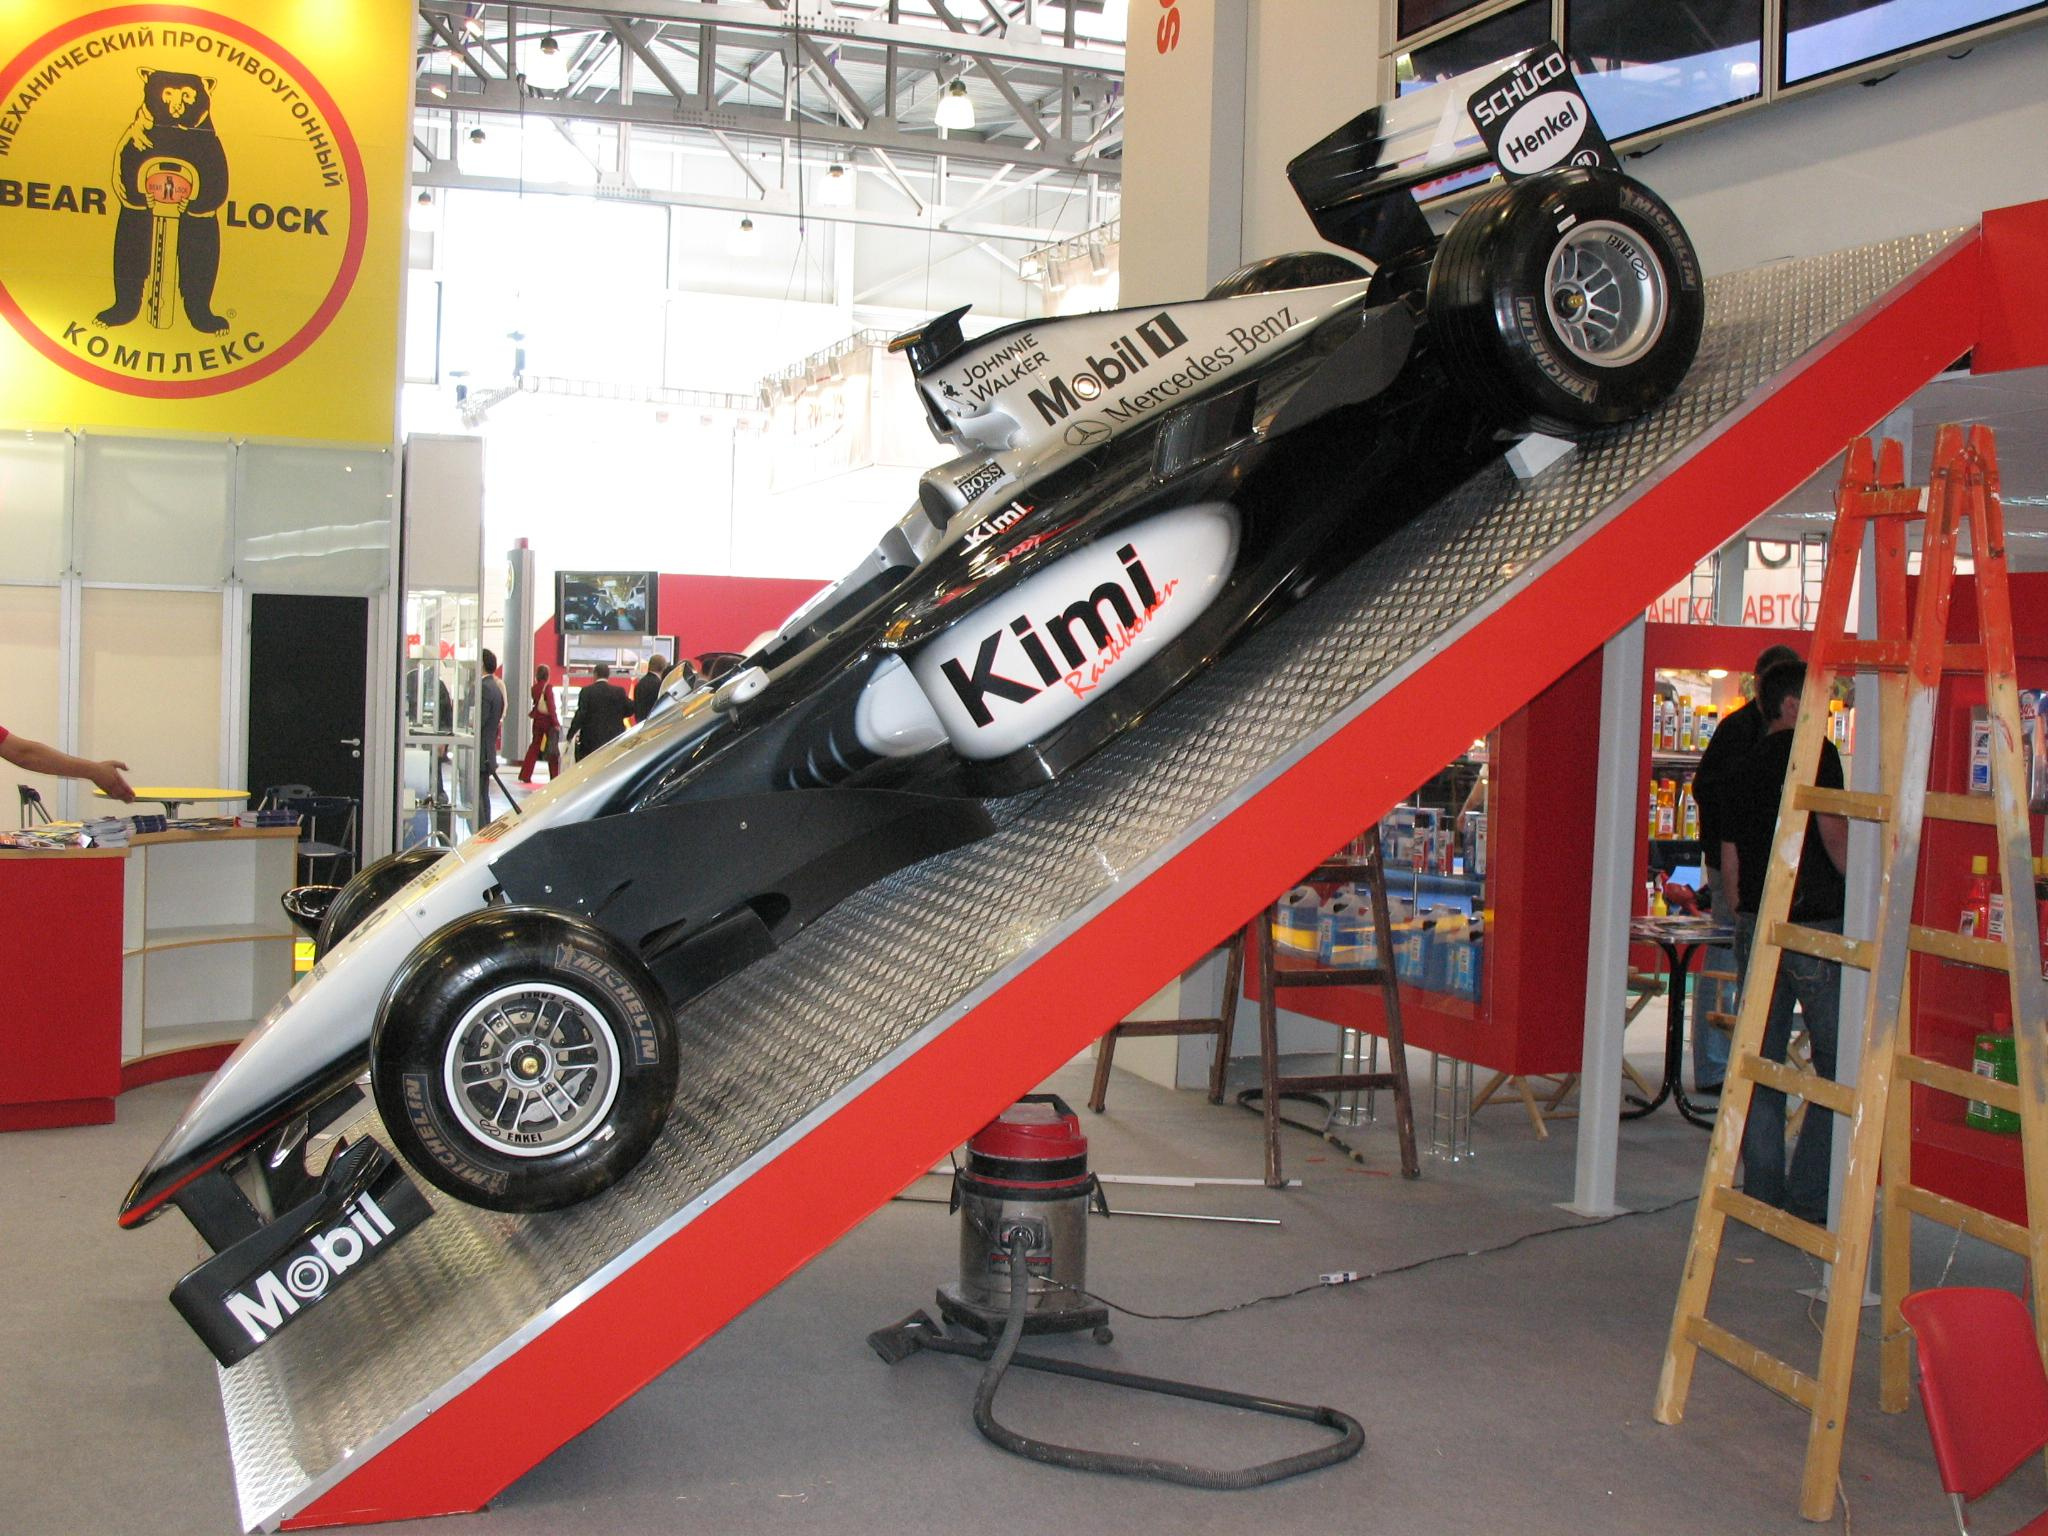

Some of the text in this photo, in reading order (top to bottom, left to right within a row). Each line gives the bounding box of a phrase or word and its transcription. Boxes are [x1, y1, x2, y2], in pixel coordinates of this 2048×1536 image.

[0, 26, 345, 188] МЕХАНИЧЕСКИЙ ПРОТИВОУГОННЫЙ
[1474, 52, 1567, 127] SCHÜCO
[1506, 101, 1579, 164] Henkel
[0, 179, 329, 236] BEAR LOCK
[1632, 195, 1699, 287] MICHELIN
[1606, 234, 1636, 259] ENKEI
[63, 320, 266, 374] КОМПЛЕКС
[962, 333, 1039, 387] JOHNNIE
[970, 351, 1050, 402] WALKER
[1027, 315, 1185, 427] Mobil 1
[1101, 306, 1300, 424] Mercedes-Benz
[1518, 300, 1585, 396] MICHELIN
[961, 465, 1001, 497] BOSS
[964, 501, 1027, 545] Kimi
[940, 543, 1155, 728] Kimi
[1743, 593, 1809, 625] АВТО
[574, 955, 658, 1061] MICHELIN
[404, 1078, 494, 1190] MICHELIN
[507, 1131, 543, 1143] ENKEI
[225, 1191, 396, 1343] Mobil
